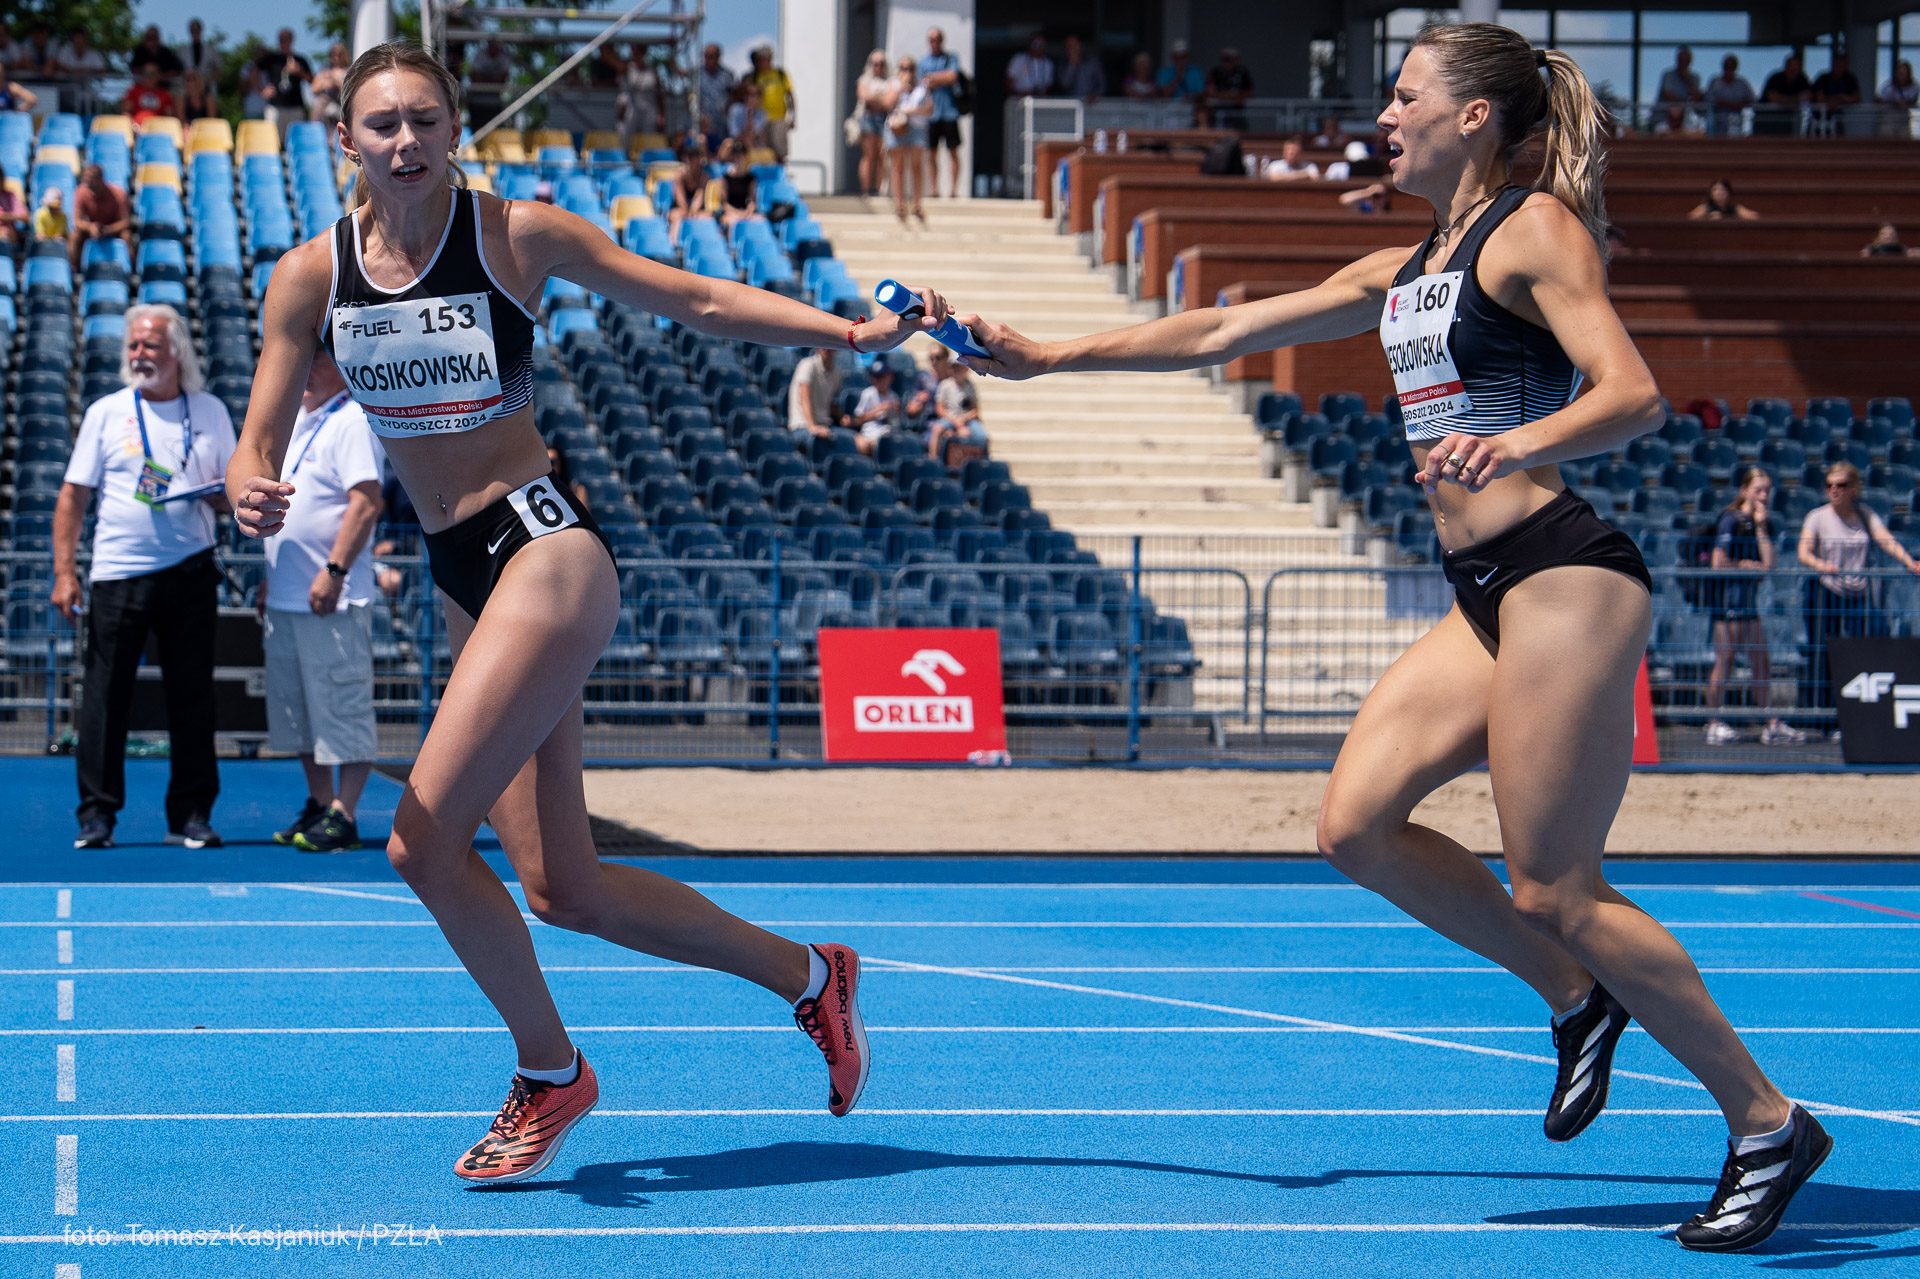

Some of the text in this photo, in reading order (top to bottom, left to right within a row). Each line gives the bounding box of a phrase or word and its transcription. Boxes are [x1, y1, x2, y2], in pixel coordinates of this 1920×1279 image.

[1415, 282, 1450, 313] 160
[338, 320, 401, 338] 4F FUEL
[418, 303, 476, 335] 153
[344, 352, 493, 392] KOSIKOWSKA
[1429, 385, 1448, 396] Polski
[407, 404, 457, 416] Mistrzostwa
[458, 401, 483, 411] Polski
[1402, 401, 1454, 421] GOSZCZ 2024
[378, 413, 487, 431] BYDGOSZCZ 2024
[526, 484, 564, 528] 6
[1841, 671, 1896, 703] 4F
[864, 704, 962, 723] ORLEN
[834, 950, 854, 1051] new balance
